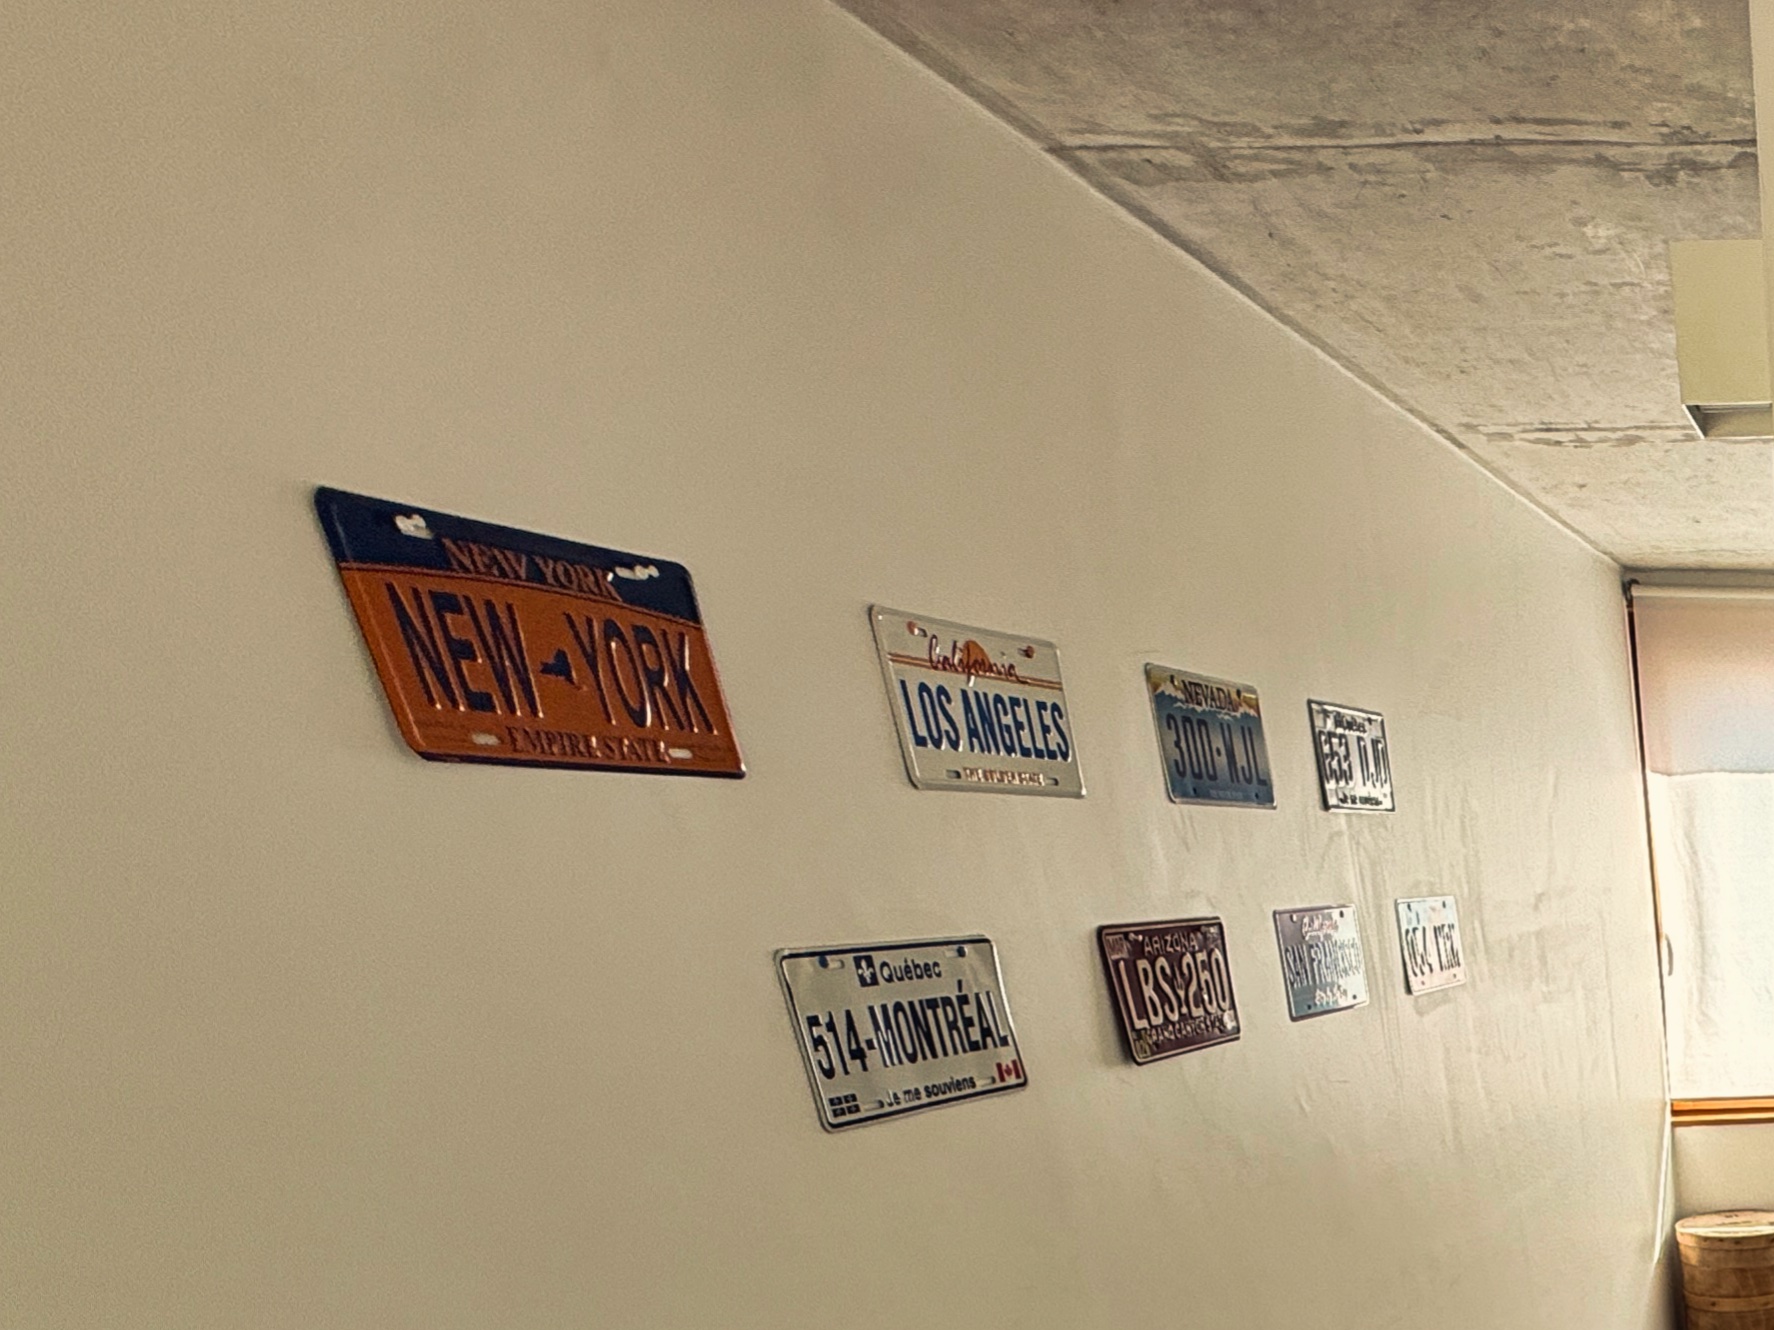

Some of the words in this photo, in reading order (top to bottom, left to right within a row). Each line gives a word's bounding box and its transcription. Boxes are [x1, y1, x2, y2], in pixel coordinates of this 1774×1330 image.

[441, 537, 528, 581] NEW
[531, 554, 623, 602] YORK
[385, 581, 544, 717] NEW
[563, 611, 719, 736] YORK
[928, 634, 1030, 687] California
[899, 679, 963, 753] LOS
[960, 688, 1073, 763] ANGELES
[1181, 679, 1239, 713] NEVADA
[504, 725, 602, 758] EMPIRE
[603, 734, 672, 765] STATE
[879, 956, 942, 984] Québec
[1143, 931, 1199, 957] ARIZONA
[1118, 955, 1179, 1030] LBS
[1181, 947, 1231, 1018] 250
[805, 979, 1011, 1081] 514-MONTRÉAL
[886, 1089, 901, 1107] Je
[903, 1087, 922, 1104] me
[923, 1075, 977, 1099] souviens
